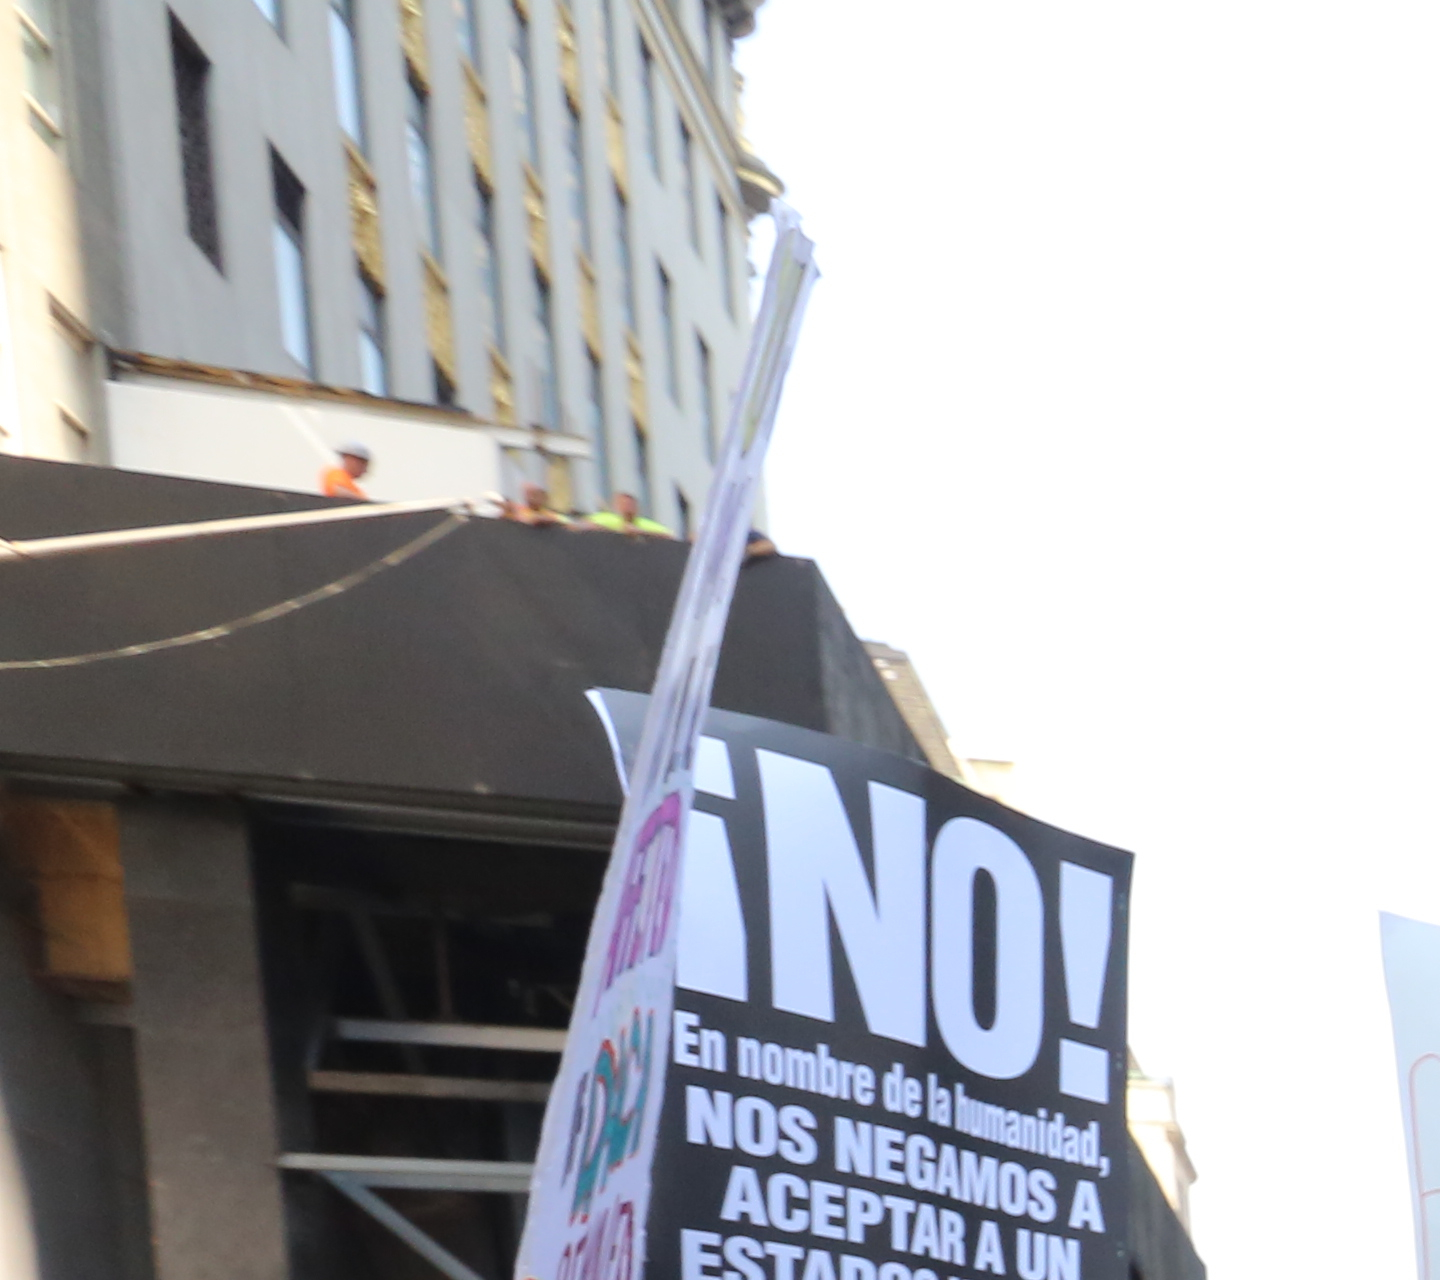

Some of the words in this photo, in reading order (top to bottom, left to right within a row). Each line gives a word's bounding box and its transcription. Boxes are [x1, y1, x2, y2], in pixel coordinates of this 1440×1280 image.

[674, 1010, 724, 1067] En
[737, 1038, 875, 1108] nombre
[883, 1058, 922, 1117] de
[927, 1072, 949, 1125] la
[955, 1082, 1110, 1178] humanidad,
[686, 1085, 818, 1168] NOS
[836, 1120, 1057, 1224] NEGAMOS
[1068, 1182, 1105, 1234] A
[721, 1166, 968, 1276] ACEPTAR
[976, 1220, 1006, 1277] A
